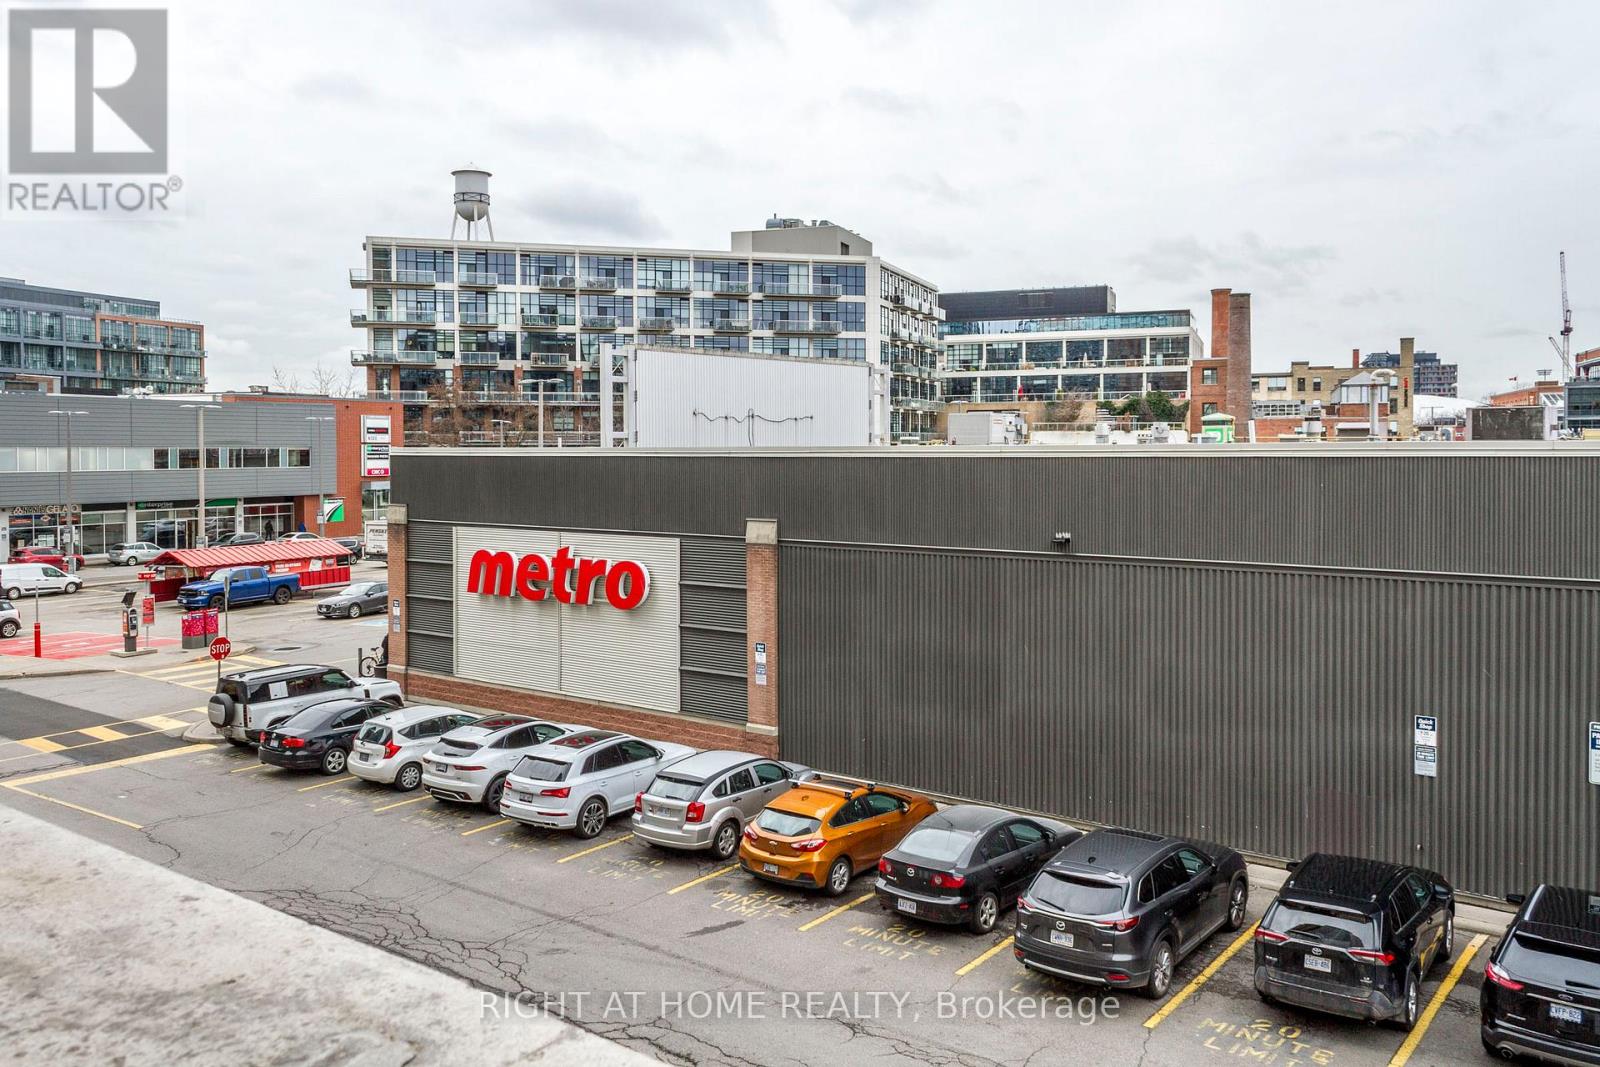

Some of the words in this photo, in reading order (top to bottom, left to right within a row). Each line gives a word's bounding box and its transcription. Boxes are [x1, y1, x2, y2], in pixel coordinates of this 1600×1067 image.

[466, 545, 650, 611] metro
[211, 644, 230, 655] STOP
[1417, 718, 1433, 727] Quick
[847, 926, 947, 956] MINUTE
[887, 923, 927, 938] 20
[843, 939, 915, 961] LIMIT
[1246, 1018, 1302, 1039] 20
[1198, 1017, 1335, 1066] MINUTE
[1203, 1036, 1304, 1067] LIMIT
